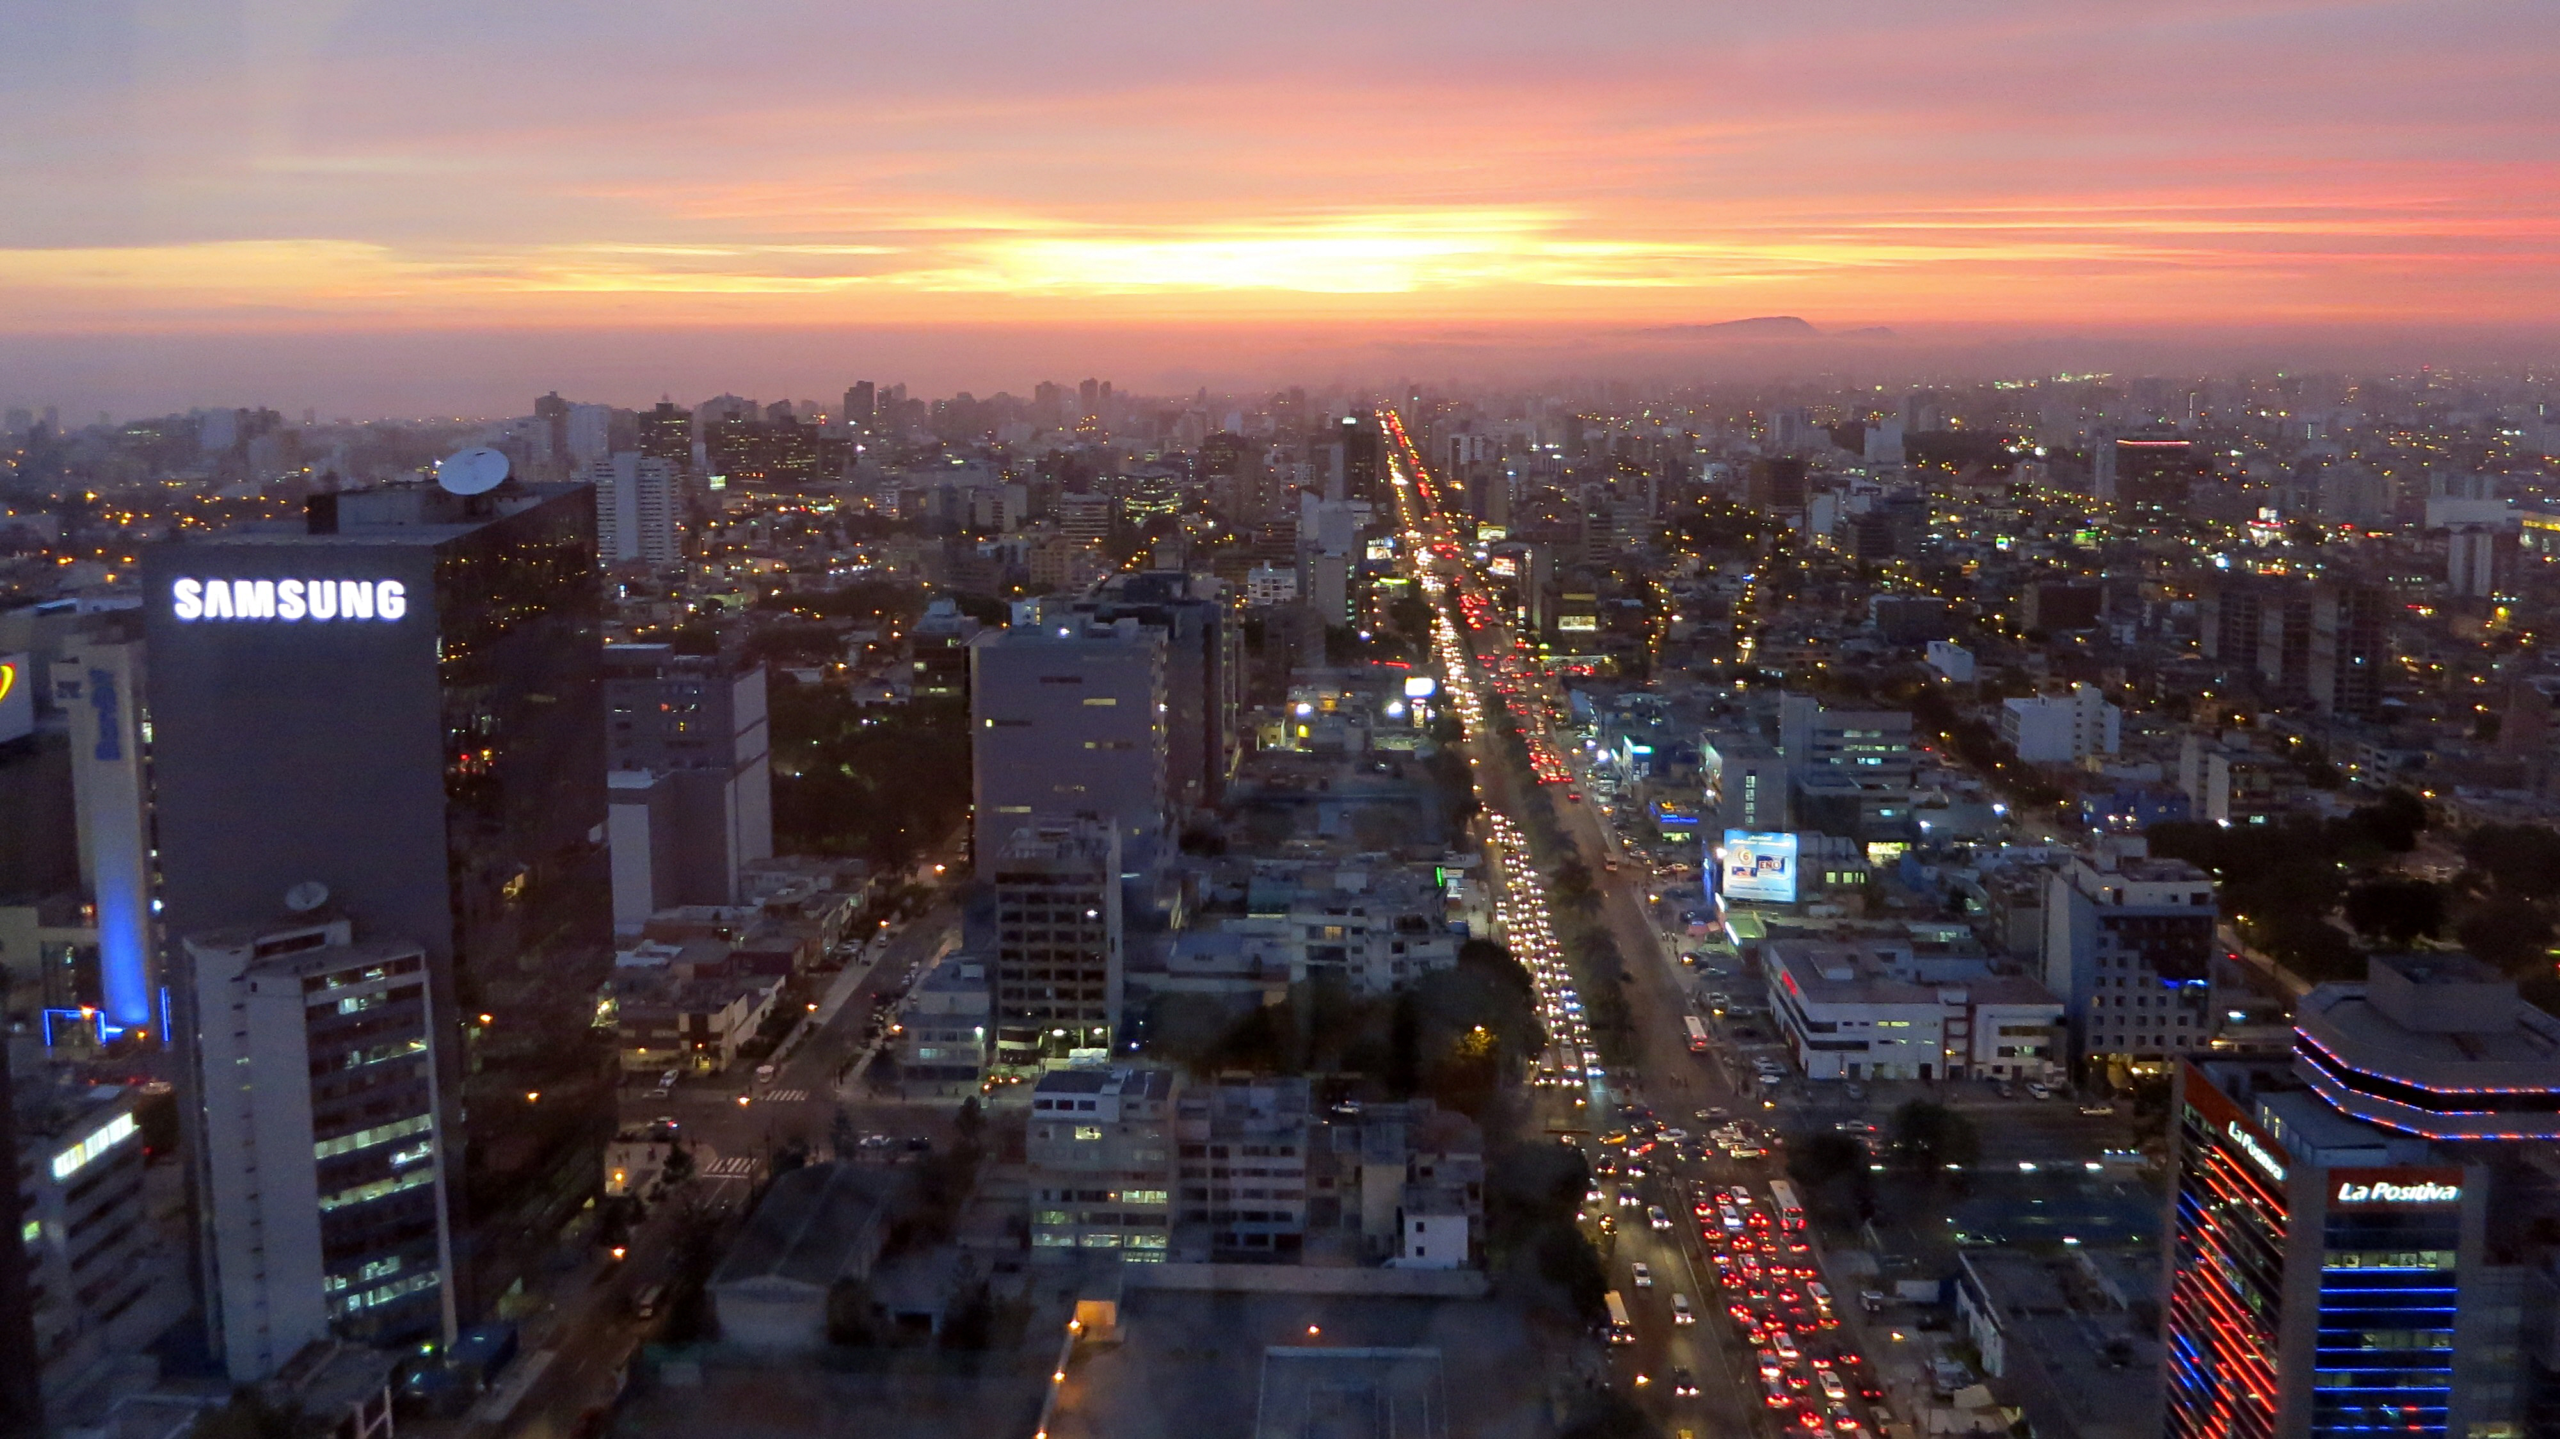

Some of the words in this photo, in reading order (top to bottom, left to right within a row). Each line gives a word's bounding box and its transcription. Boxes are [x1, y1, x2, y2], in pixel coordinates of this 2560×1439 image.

[174, 578, 406, 619] SAMSUNG
[1760, 861, 1781, 869] ENO
[2228, 1121, 2243, 1143] La
[2338, 1183, 2369, 1201] La
[2371, 1182, 2459, 1201] Positiva
